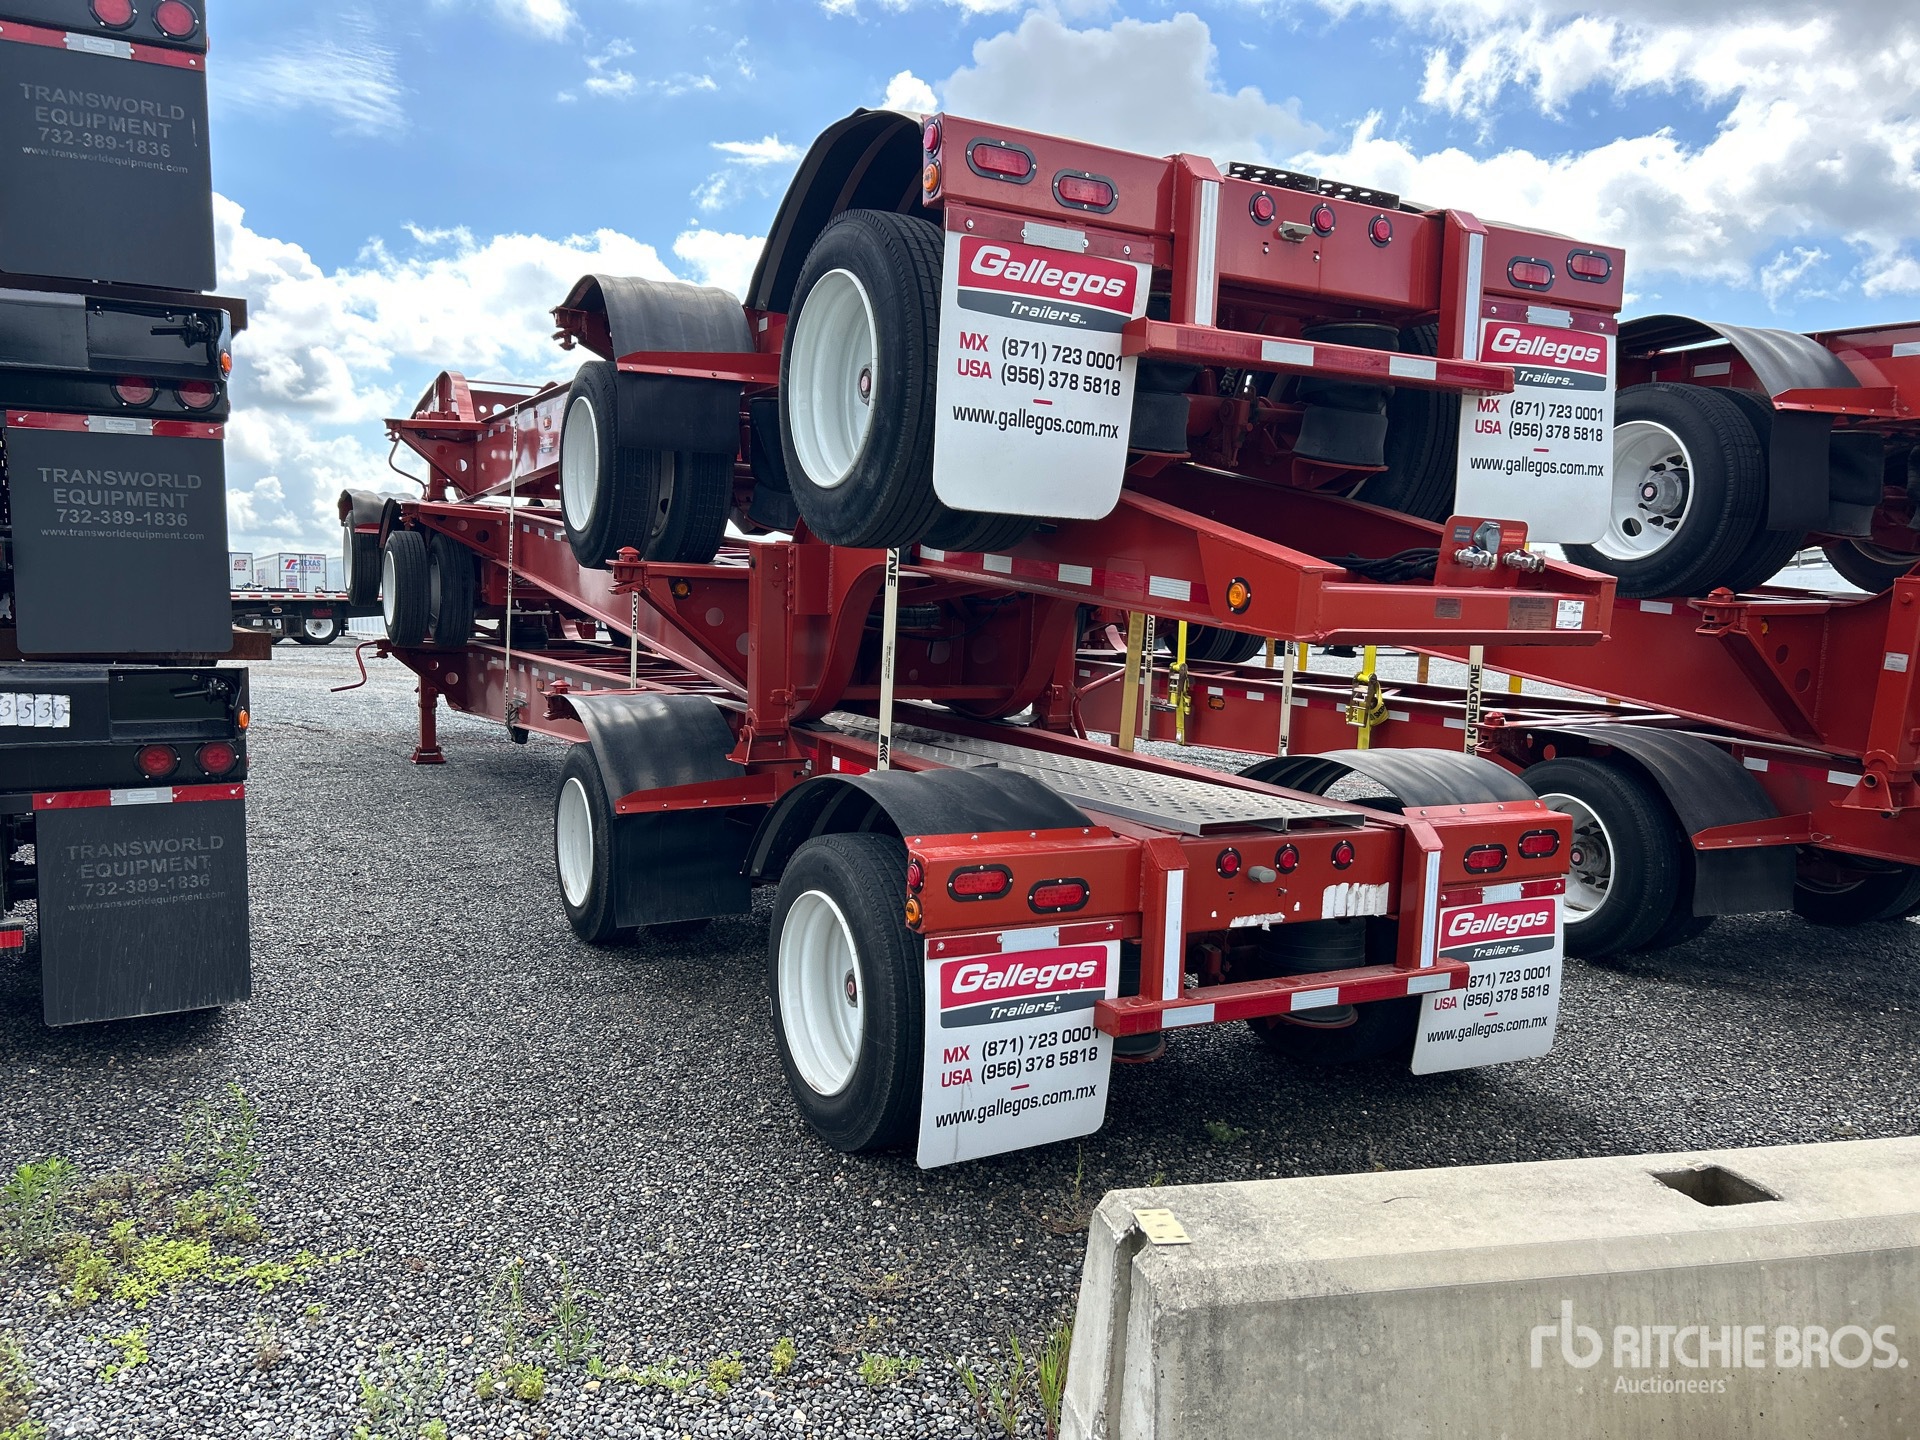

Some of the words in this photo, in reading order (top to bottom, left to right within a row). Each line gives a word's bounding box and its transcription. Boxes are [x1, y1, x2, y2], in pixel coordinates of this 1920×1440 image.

[19, 82, 186, 121] TRANSWORLD
[35, 106, 172, 139] EQUIPMENT
[38, 127, 171, 158] 732-389-1836
[22, 145, 188, 174] www.transworldequipment.com
[970, 244, 1126, 297] Gallegos
[1009, 300, 1081, 323] Trailers
[959, 331, 989, 352] MX
[1001, 336, 1047, 365] (871)
[1052, 345, 1082, 365] 723
[1086, 349, 1122, 372] 0001
[1491, 327, 1601, 364] Gallegos
[957, 358, 992, 379] USA
[1001, 362, 1045, 390] (956)
[1048, 371, 1078, 391] 378
[1083, 376, 1121, 397] 5818
[1518, 370, 1570, 386] Trailers
[952, 405, 1119, 439] www.gallegos.com.mx
[1477, 398, 1500, 413] MX
[1510, 400, 1545, 420] (871)
[1548, 403, 1572, 420] 723
[1575, 406, 1603, 422] 0001
[1474, 419, 1502, 435] USA
[1508, 421, 1543, 441] (956)
[1545, 424, 1570, 440] 378
[1573, 426, 1603, 442] 5818
[37, 467, 202, 489] TRANSWORLD
[1470, 456, 1604, 477] www.gallegos.com.mx
[52, 489, 188, 509] EQUIPMENT
[56, 508, 188, 527] 732-389-1836
[40, 527, 205, 540] www.transworldequipment.com
[1467, 664, 1481, 739] KINEDYNE
[66, 835, 224, 861] TRANSWORLD
[80, 855, 211, 879] EQUIPMENT
[82, 874, 210, 897] 732-389-1836
[68, 891, 226, 911] www.transworldequipment.com
[1448, 910, 1549, 937] Gallegos
[1472, 944, 1520, 959] Trailers
[951, 960, 1098, 994] Gallegos
[1499, 970, 1521, 985] 723
[1523, 965, 1551, 981] 0001
[1434, 996, 1457, 1010] USA
[1463, 991, 1494, 1010] (956)
[1495, 987, 1518, 1002] 378
[1520, 984, 1550, 999] 5818
[989, 1002, 1055, 1019] Trailers
[1427, 1015, 1548, 1043] www.gallegos.com.mx
[943, 1044, 970, 1064] MX
[981, 1035, 1024, 1060] (871)
[1028, 1032, 1058, 1051] 723
[1062, 1026, 1099, 1044] 0001
[940, 1068, 973, 1088] USA
[981, 1058, 1022, 1085] (956)
[1025, 1055, 1055, 1073] 378
[1059, 1046, 1098, 1067] 5818
[935, 1084, 1097, 1128] www.gallegos.com.mx
